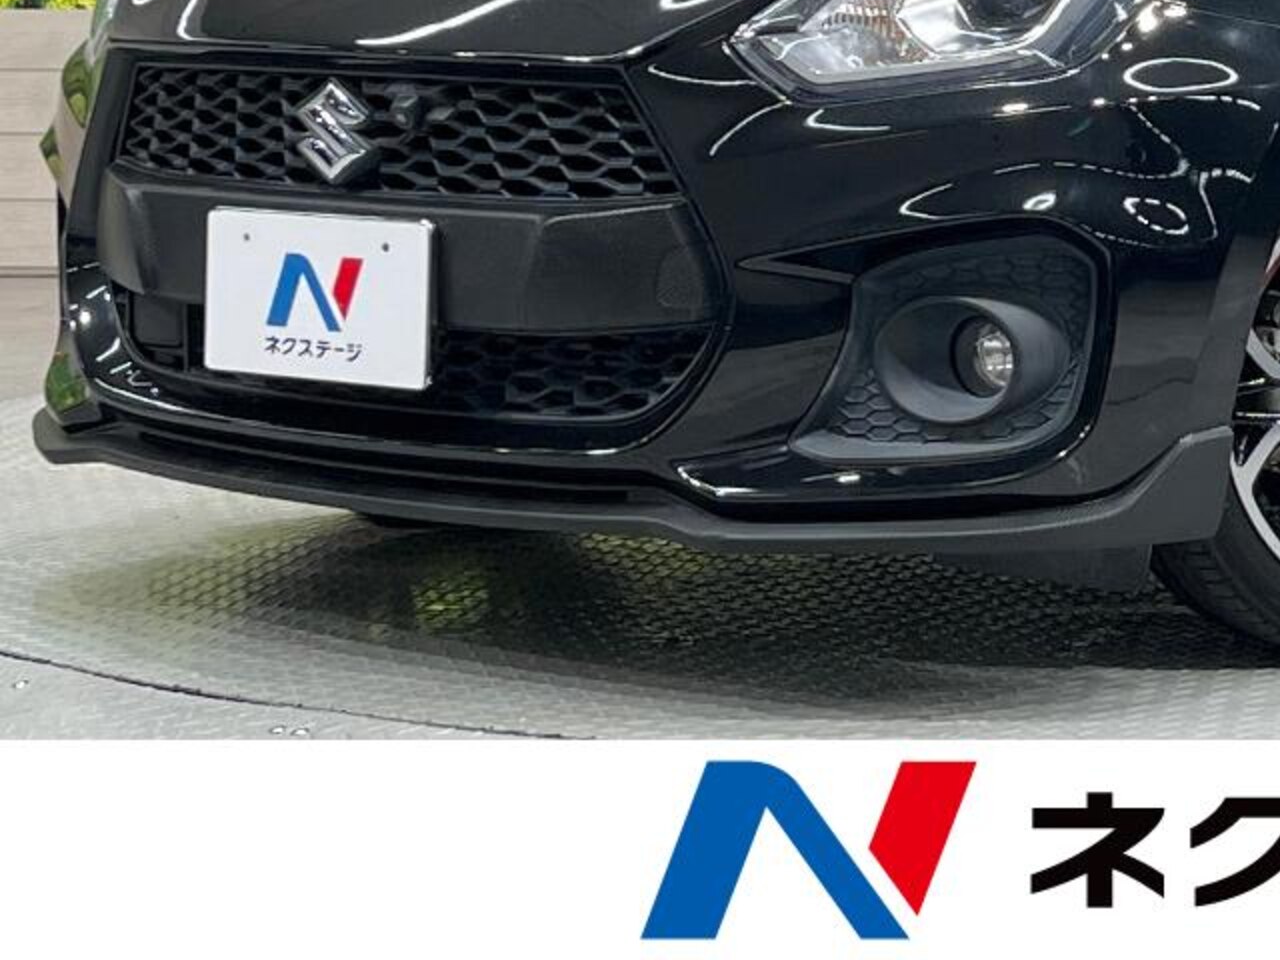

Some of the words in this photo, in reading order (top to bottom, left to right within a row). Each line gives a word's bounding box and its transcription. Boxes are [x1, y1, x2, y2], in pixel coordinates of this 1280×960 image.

[264, 336, 363, 362] ネクステージ
